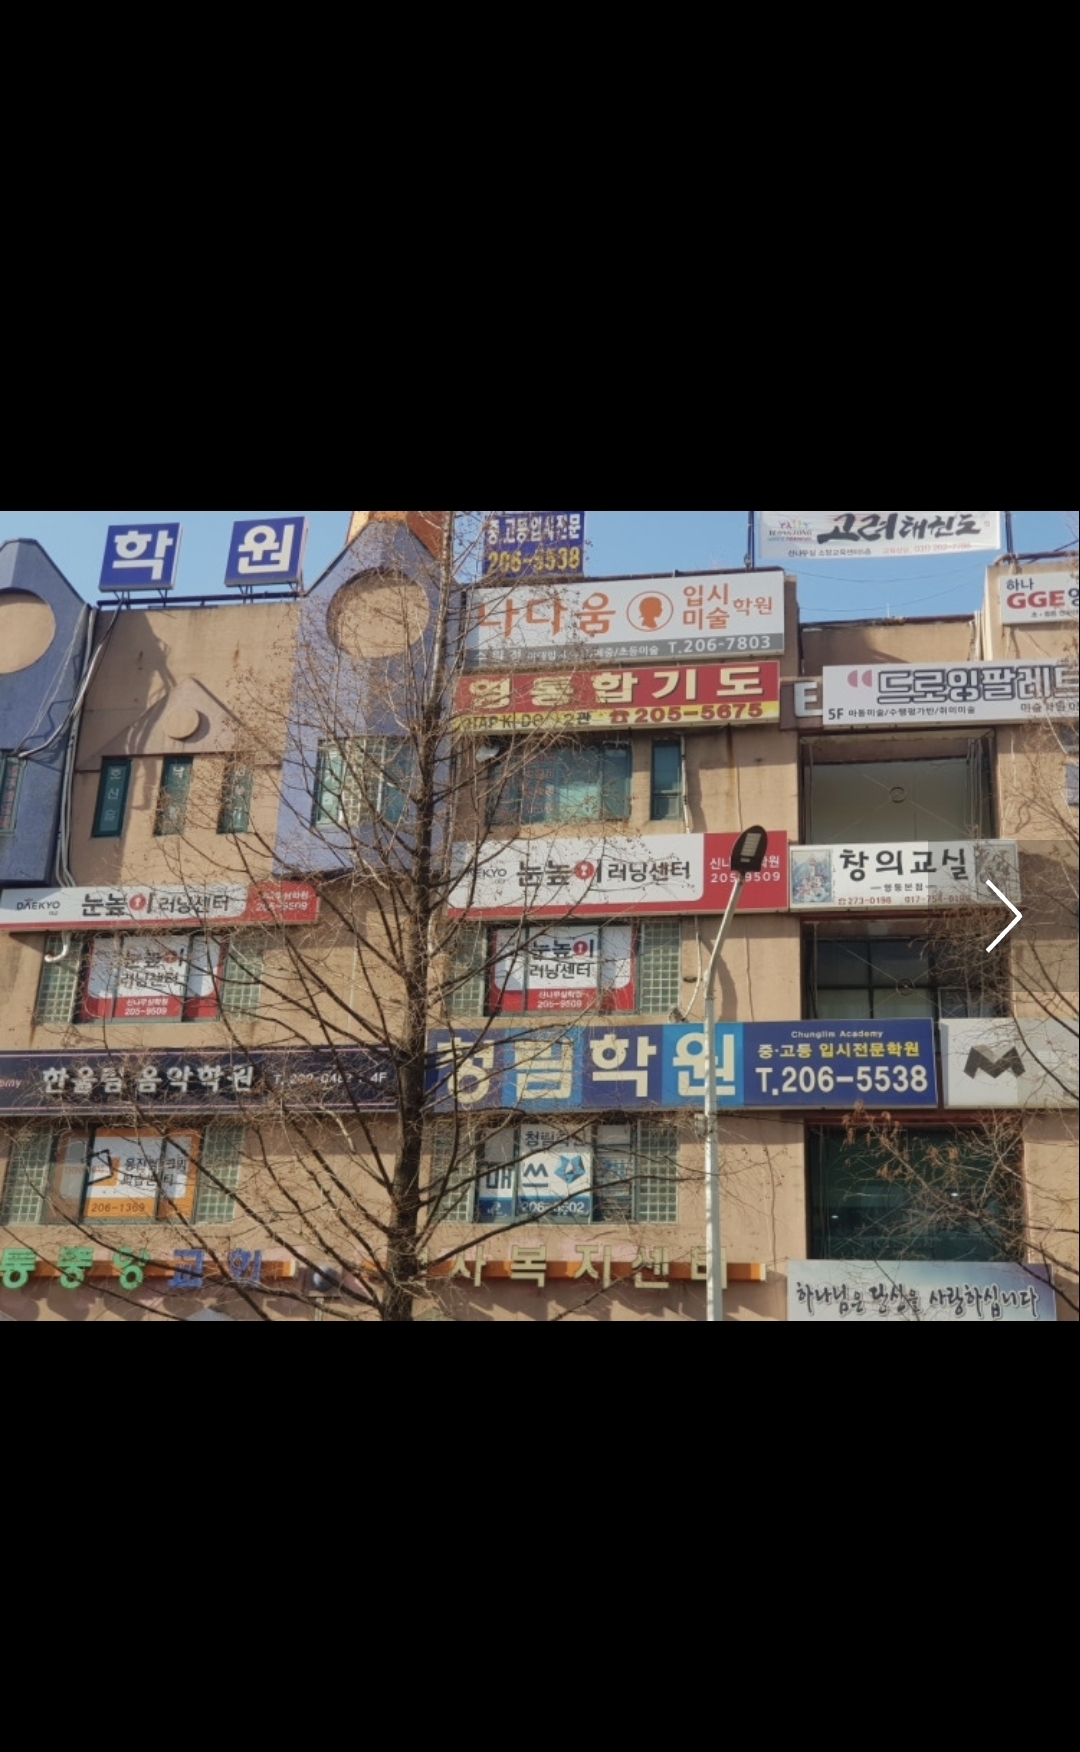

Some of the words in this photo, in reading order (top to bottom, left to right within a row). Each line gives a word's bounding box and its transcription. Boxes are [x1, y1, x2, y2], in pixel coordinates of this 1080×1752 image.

[817, 513, 898, 544] 고려
[682, 583, 729, 604] 입시
[1006, 577, 1034, 591] 하나
[1006, 590, 1065, 609] GGE
[477, 592, 616, 637] 나다움
[682, 608, 730, 630] 미술
[732, 596, 773, 617] 학원
[668, 636, 771, 654] T.206-7803
[635, 703, 762, 723] 205-5675
[828, 708, 844, 720] 5F
[517, 858, 601, 887] 눈높이
[607, 860, 691, 883] 러닝센터
[840, 848, 968, 882] 창의교실
[710, 871, 781, 883] 2059509
[16, 901, 61, 910] DAEKYO
[529, 962, 592, 979] 러닝센터
[839, 1030, 883, 1039] Academy
[819, 1041, 920, 1059] 입시전문학원
[436, 1032, 737, 1104] 청림학원
[42, 1066, 124, 1094] 한울림
[137, 1064, 256, 1094] 음악학원
[370, 1071, 388, 1083] 4F
[755, 1064, 928, 1096] T.206-5538
[795, 1281, 865, 1316] 하나님은
[928, 1285, 1039, 1320] 사랑하십니다
